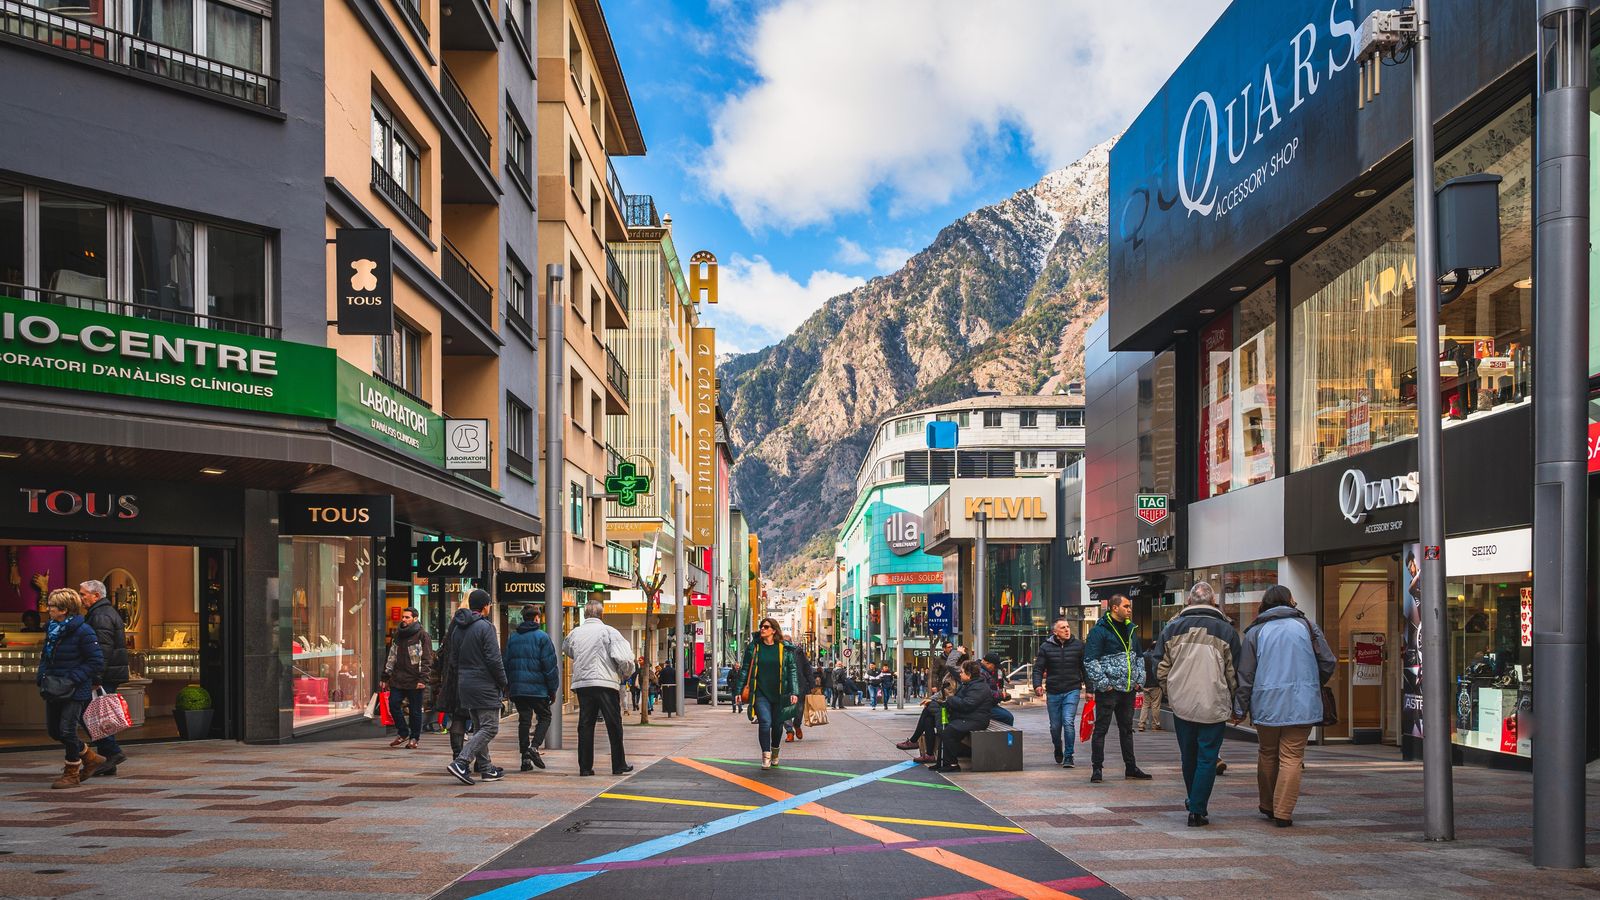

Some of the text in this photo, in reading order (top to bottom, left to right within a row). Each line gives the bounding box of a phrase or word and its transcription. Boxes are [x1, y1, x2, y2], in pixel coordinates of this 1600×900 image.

[1177, 0, 1355, 218] QUARS
[1215, 163, 1267, 221] ACCESSORY
[1270, 137, 1299, 177] SHOP
[346, 297, 382, 305] TOUS
[0, 352, 274, 398] ORATORI D'ANÀLISIS CLÍNIQUES
[698, 367, 711, 415] casa
[360, 382, 428, 436] LABORATORI
[698, 428, 713, 495] canut
[20, 487, 140, 519] TOUS
[308, 507, 370, 523] TOUS
[1141, 498, 1165, 508] TAG
[1141, 510, 1165, 521] HEUER
[887, 511, 918, 542] illa
[1365, 520, 1403, 534] ACCESSORY SHOP
[1472, 545, 1498, 557] SEIKO
[505, 583, 546, 593] LOTTUSS
